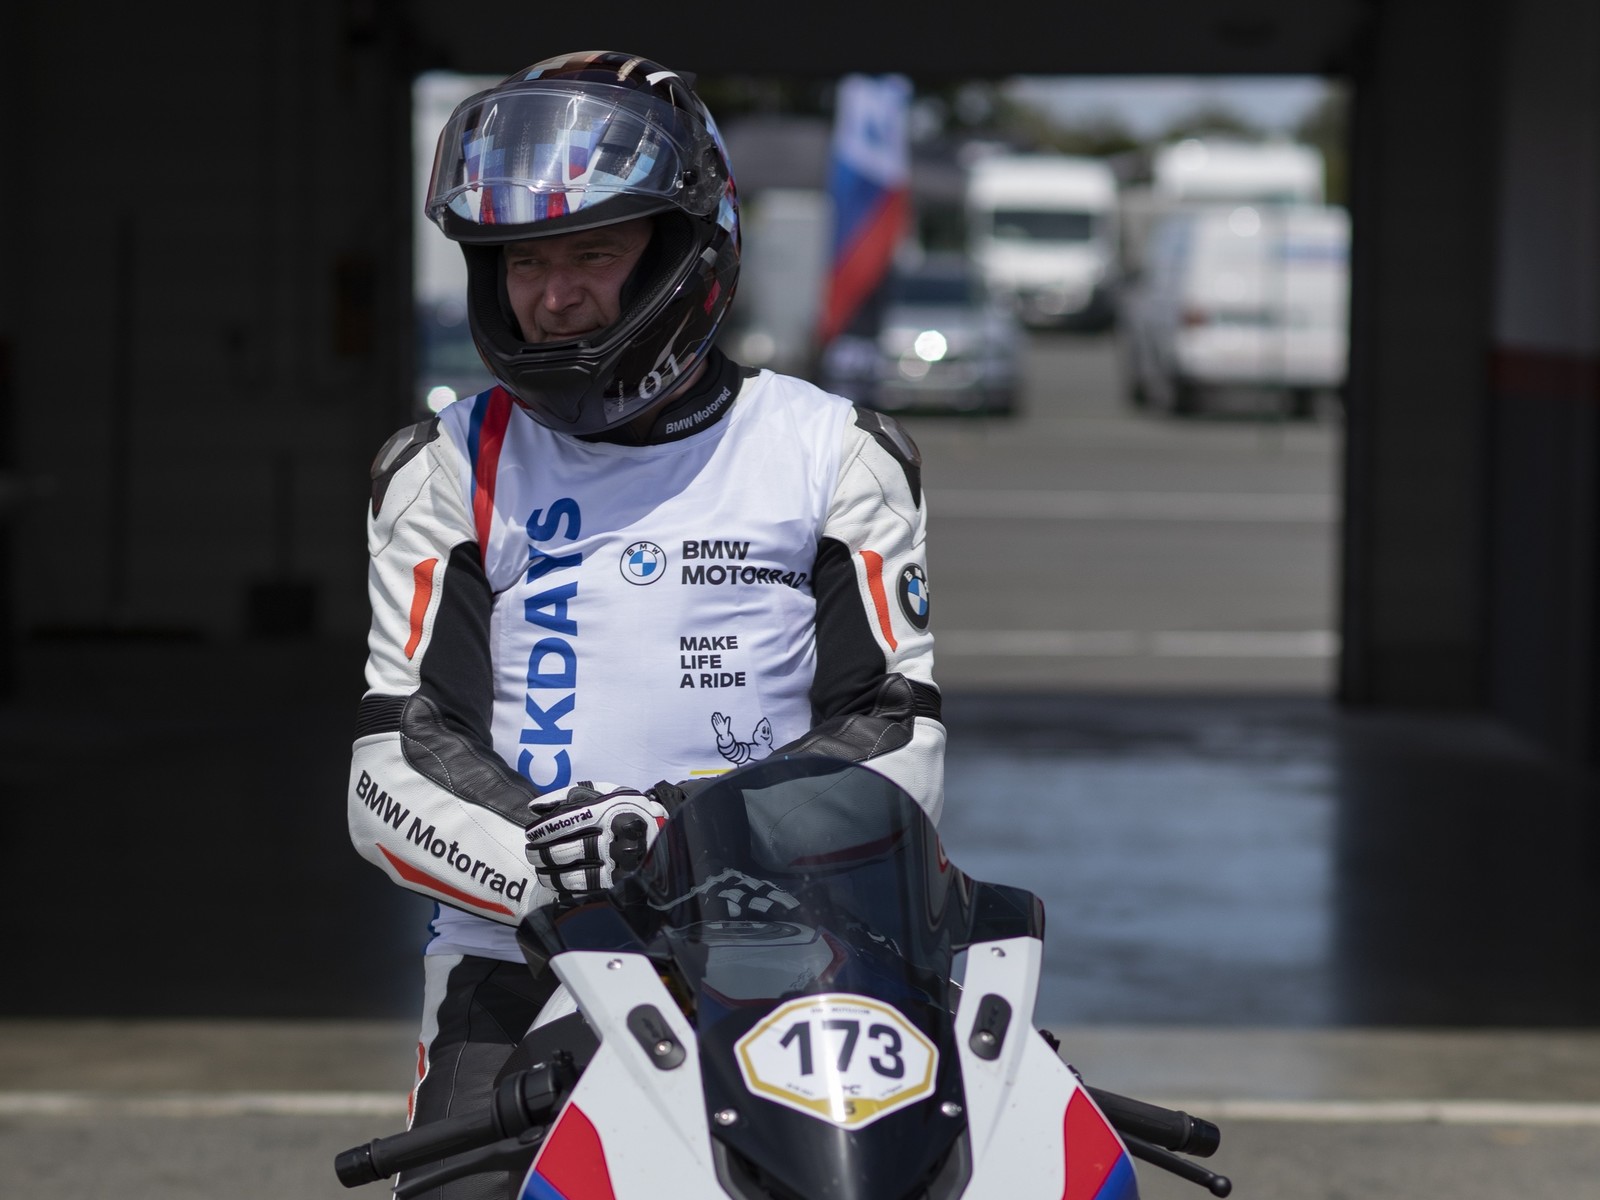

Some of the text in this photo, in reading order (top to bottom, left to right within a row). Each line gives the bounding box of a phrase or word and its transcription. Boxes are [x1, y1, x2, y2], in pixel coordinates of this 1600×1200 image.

[665, 387, 731, 434] BMW Motorrad
[682, 540, 750, 560] BMW
[681, 565, 808, 588] MOTORRAD
[680, 636, 739, 651] MAKE
[680, 655, 722, 669] LIFE
[680, 672, 746, 689] A RIDE
[355, 770, 527, 902] BMW Motorrad
[527, 809, 592, 842] BMW Motorrad
[779, 1019, 905, 1080] 173
